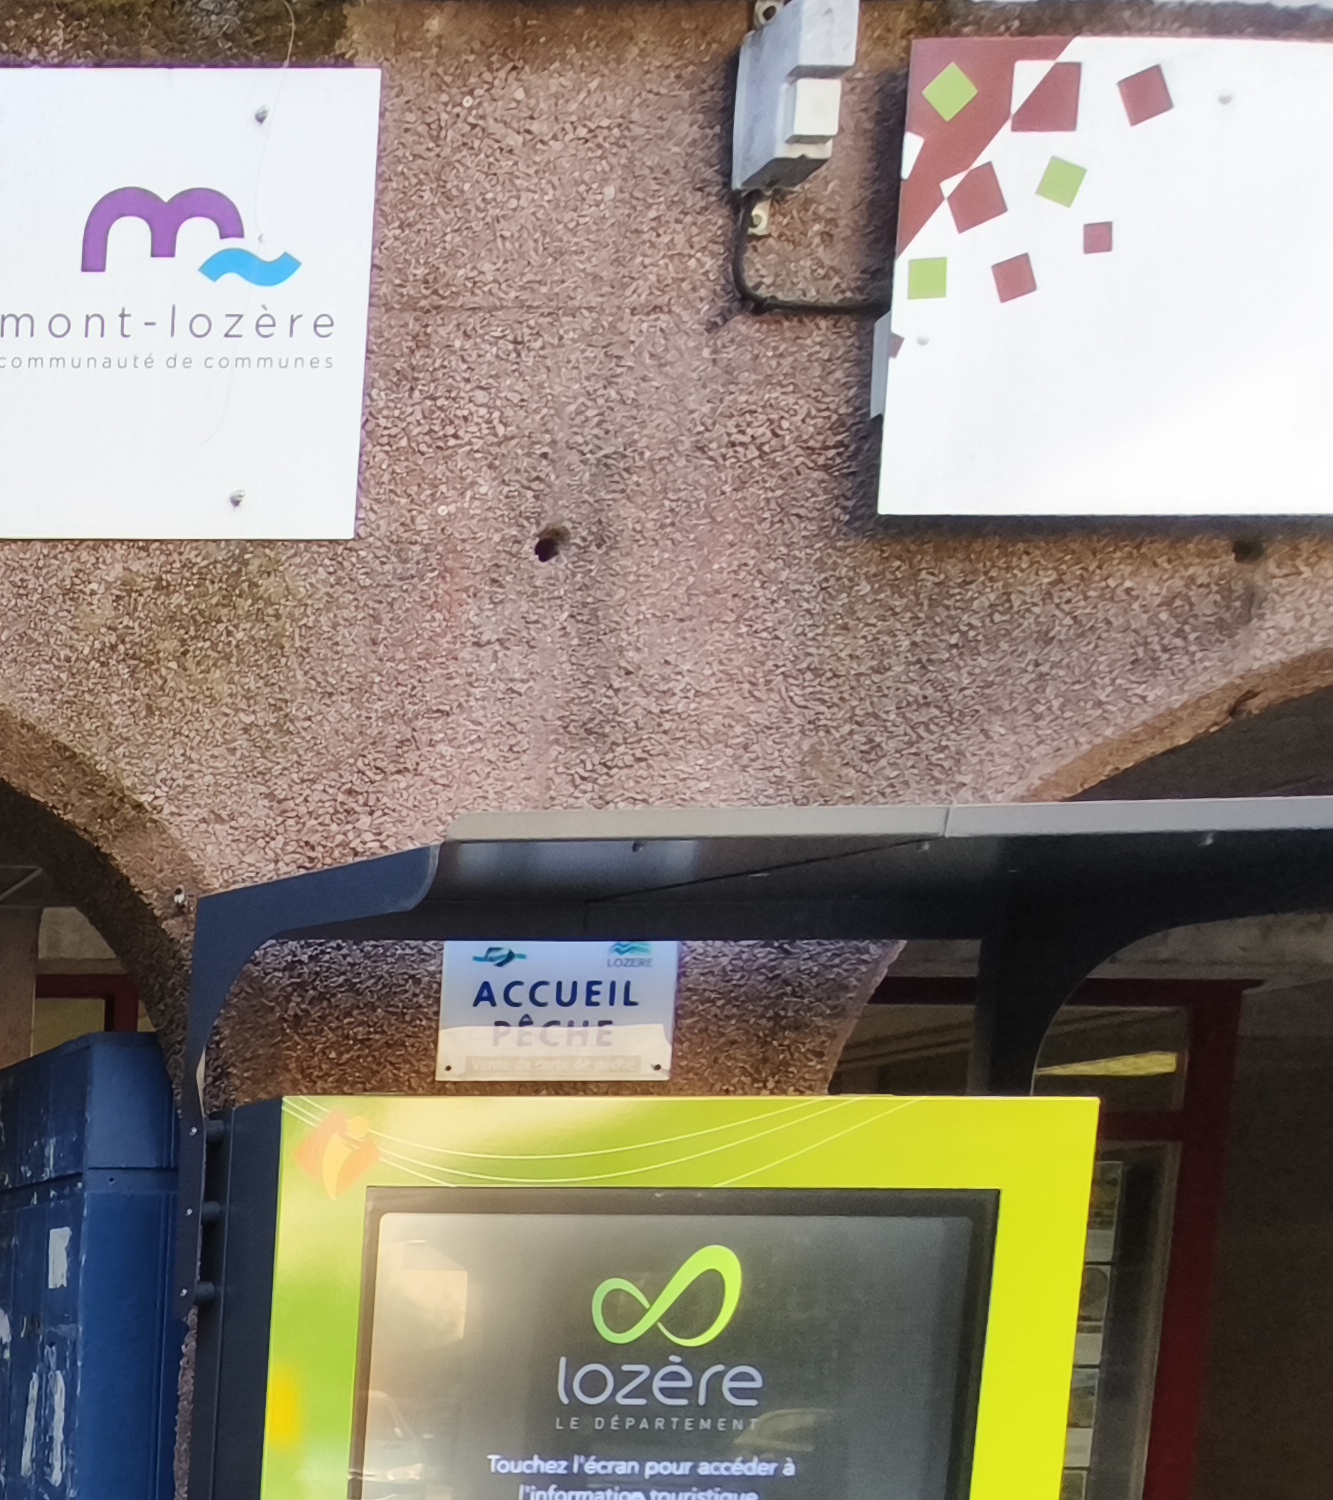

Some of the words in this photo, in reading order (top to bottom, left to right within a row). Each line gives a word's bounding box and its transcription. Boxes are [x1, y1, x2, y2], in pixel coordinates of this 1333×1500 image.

[0, 304, 336, 339] mont-lozère
[165, 353, 194, 370] de
[203, 354, 335, 370] communes
[471, 980, 640, 1008] ACCUEIL
[491, 1013, 614, 1047] PÊCHE
[557, 1354, 764, 1407] lozère
[555, 1417, 580, 1430] LE
[594, 1414, 759, 1431] DÉPARTEMENT
[487, 1455, 568, 1475] Touchez
[573, 1456, 639, 1476] l'écran
[644, 1460, 693, 1480] pour
[697, 1457, 779, 1477] accéder
[782, 1457, 796, 1477] à
